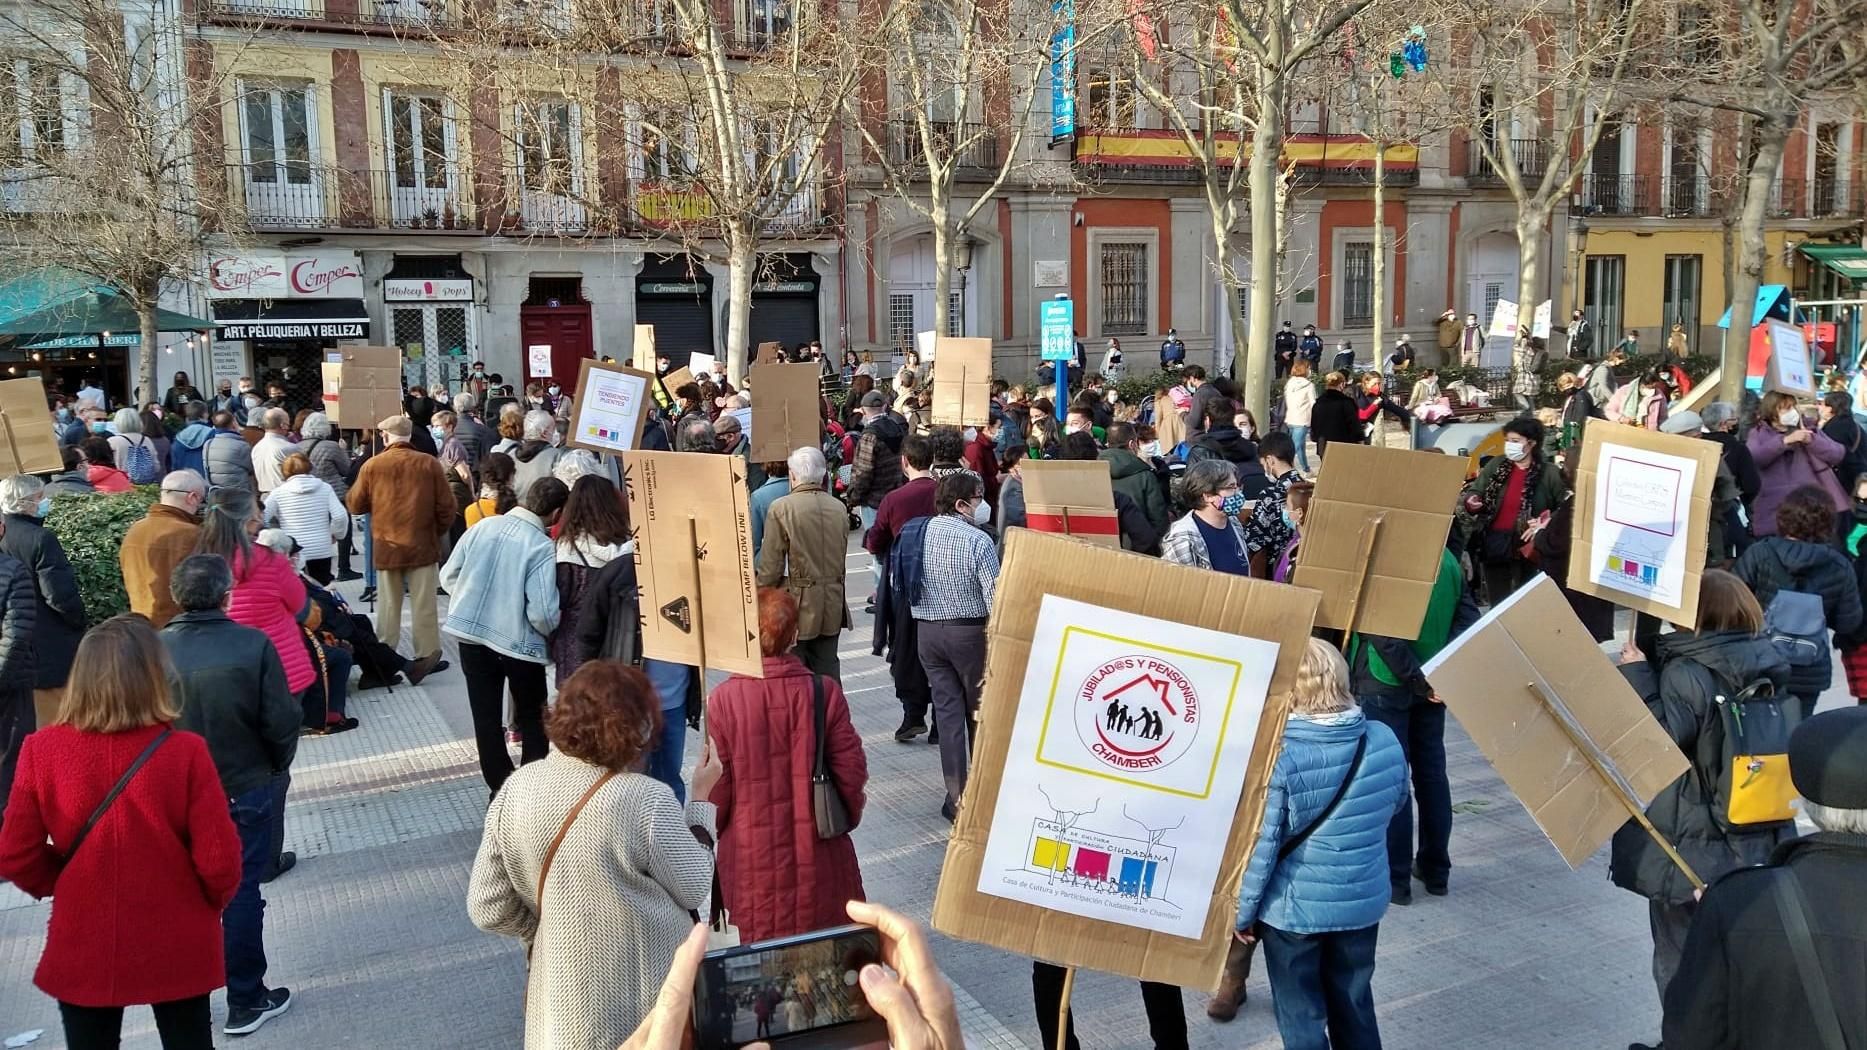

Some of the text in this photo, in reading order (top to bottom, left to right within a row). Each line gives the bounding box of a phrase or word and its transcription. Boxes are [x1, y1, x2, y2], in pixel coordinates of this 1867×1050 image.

[291, 258, 357, 295] Comper
[224, 324, 363, 339] ART. PELUQUERIA Y BELLEZA
[738, 511, 752, 604] CLAMP BELOW LINE
[1082, 659, 1197, 724] JUBILAD@S Y PENSIONISTAS
[1038, 821, 1066, 833] CASA
[1107, 845, 1169, 862] CIUDADANA
[1002, 876, 1018, 886] Casa
[1018, 880, 1028, 888] de
[1029, 883, 1053, 894] Cultura
[1104, 900, 1138, 912] Ciudadana
